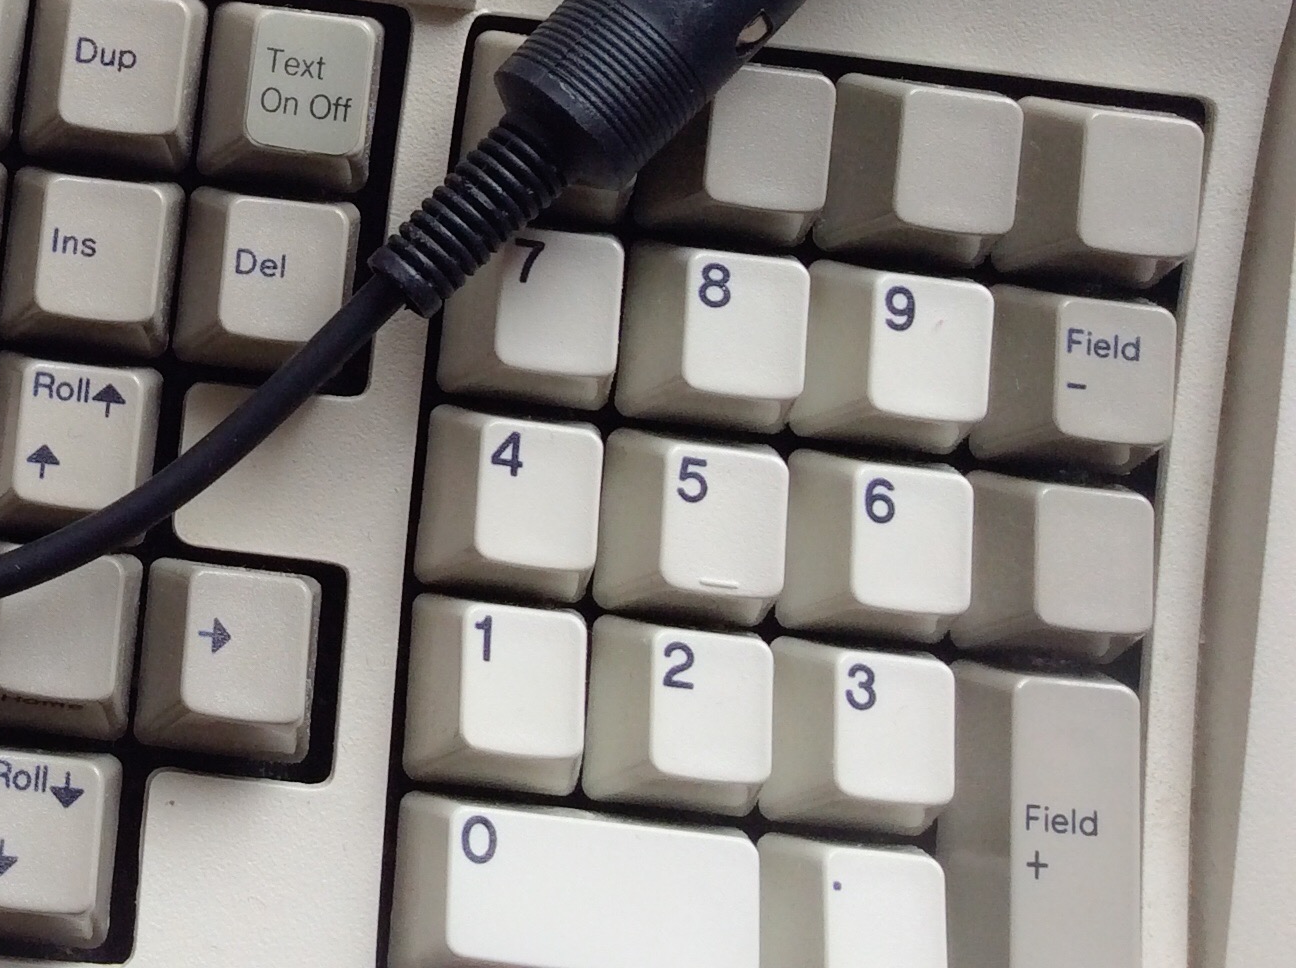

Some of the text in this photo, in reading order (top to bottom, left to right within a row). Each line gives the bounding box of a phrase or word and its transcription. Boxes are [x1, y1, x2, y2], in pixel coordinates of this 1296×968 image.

[76, 38, 136, 72] Dup
[267, 48, 325, 80] Text
[261, 87, 352, 122] On Off
[52, 228, 96, 257] Ins
[514, 237, 546, 284] 7
[236, 249, 285, 277] Del
[699, 263, 730, 308] 8
[885, 286, 915, 331] 9
[1067, 328, 1140, 361] Field
[34, 372, 88, 403] Roll
[491, 432, 523, 476] 4
[678, 457, 708, 503] 5
[865, 479, 895, 523] 6
[475, 616, 492, 661] 1
[663, 642, 694, 689] 2
[846, 664, 876, 710] 3
[1026, 804, 1098, 836] Field
[1027, 851, 1048, 879] +
